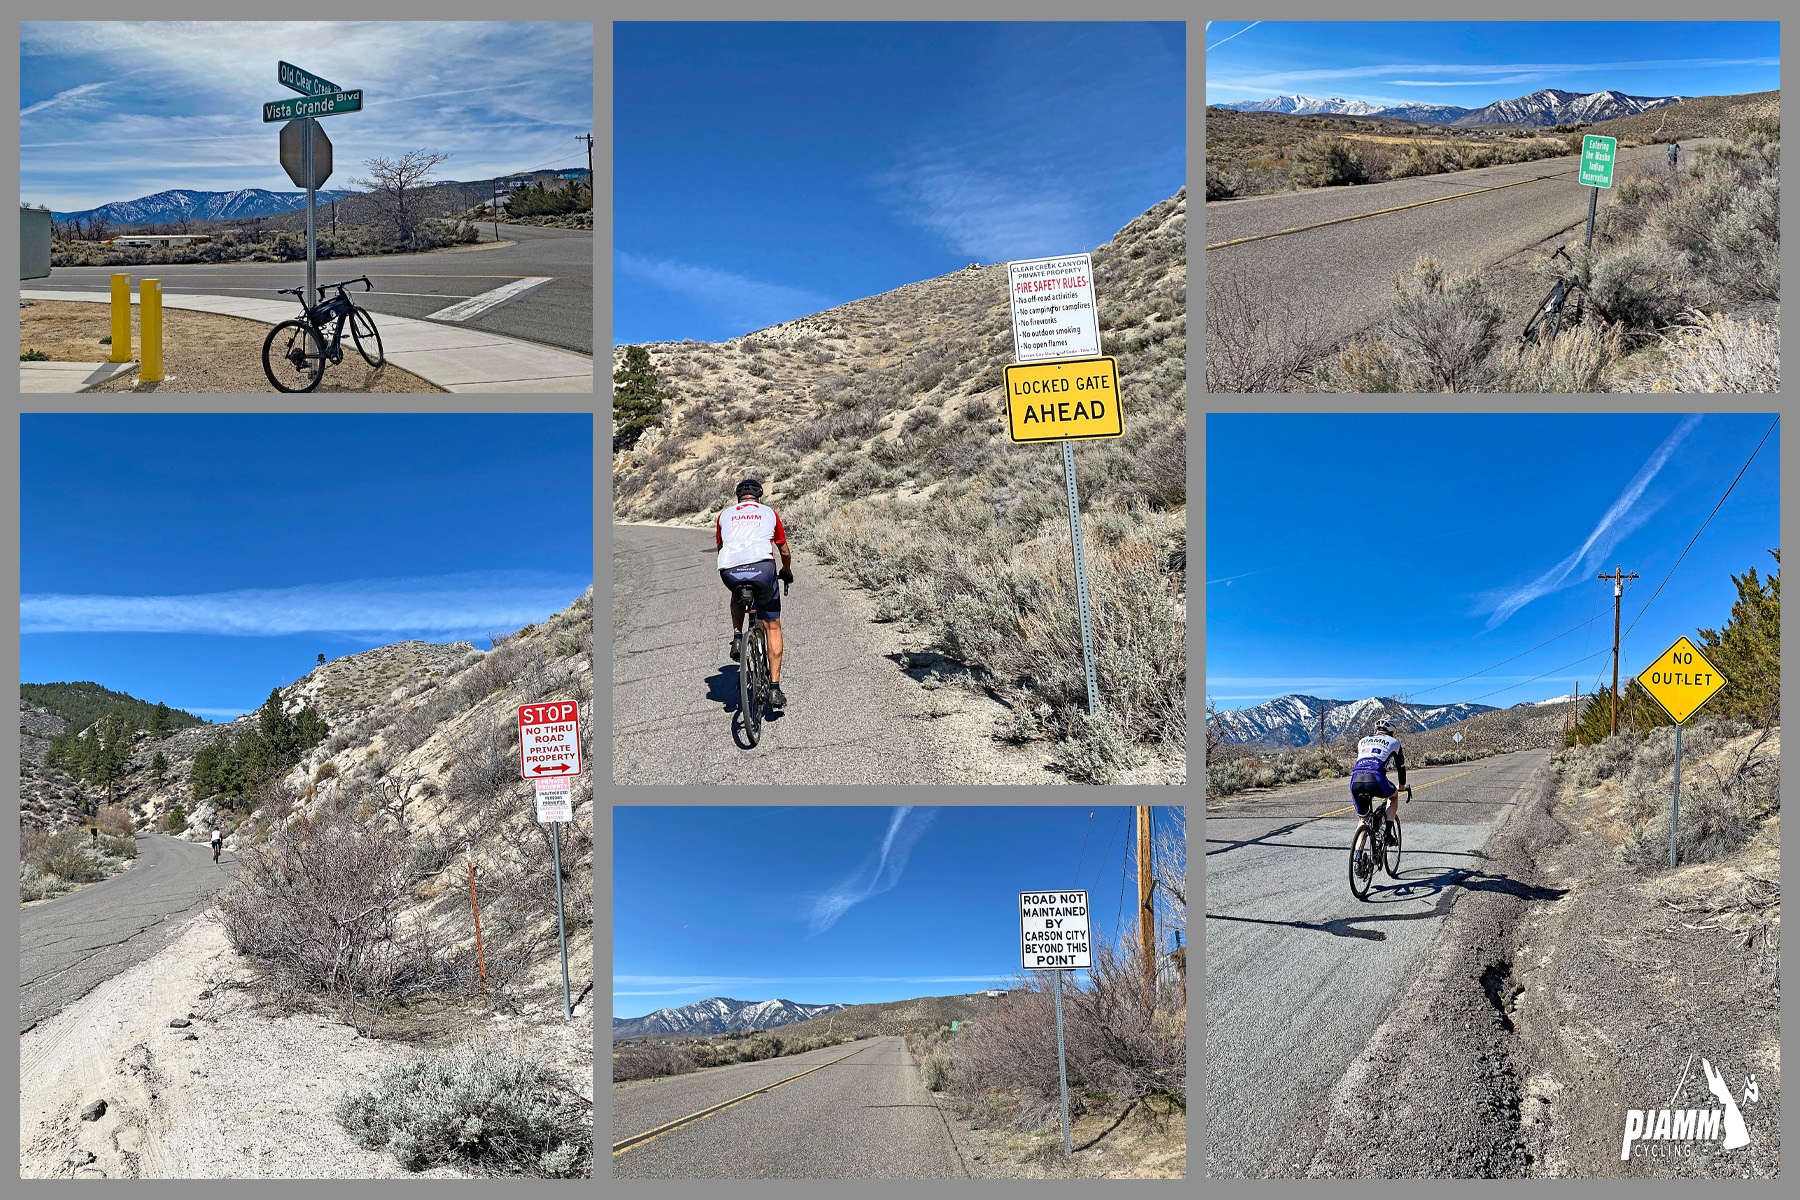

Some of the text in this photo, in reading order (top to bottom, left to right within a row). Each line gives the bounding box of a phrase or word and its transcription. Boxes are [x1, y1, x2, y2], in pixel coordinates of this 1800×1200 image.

[281, 64, 294, 84] Old
[295, 70, 311, 91] Clear
[313, 79, 331, 95] Creek
[266, 91, 360, 119] Vista Grande Blvd
[1590, 139, 1609, 152] Entering
[1586, 150, 1594, 159] the
[1589, 161, 1604, 172] Indian
[1582, 170, 1609, 183] Reservation
[1012, 259, 1087, 273] CLEAR CREEK CANYON
[1018, 267, 1082, 279] PRIVATE PROPERTY
[1033, 278, 1061, 292] SAFETY
[1027, 294, 1051, 303] off-road
[1051, 291, 1078, 300] activities
[1029, 305, 1054, 315] camping
[1062, 302, 1091, 311] campfires
[1030, 316, 1057, 326] fireworks
[1031, 328, 1055, 338] outdoor
[1056, 325, 1081, 335] smoking
[1032, 342, 1047, 351] open
[1048, 339, 1068, 347] flames
[1014, 374, 1110, 396] LOCKED GATE
[1023, 400, 1106, 424] AHEAD
[1673, 652, 1692, 665] NO
[1652, 672, 1712, 686] OUTLET
[523, 704, 573, 724] STOP
[526, 724, 573, 735] NO THRU
[535, 734, 565, 744] ROAD
[530, 744, 571, 754] PRIVATE
[526, 753, 576, 763] PROPERTY
[1023, 894, 1084, 905] ROAD NOT
[1023, 906, 1086, 918] MAINTAINED
[1045, 919, 1064, 929] BY
[1025, 930, 1086, 941] CARSON CITY
[1025, 942, 1088, 954] BEYOND THIS
[1037, 955, 1076, 966] POINT
